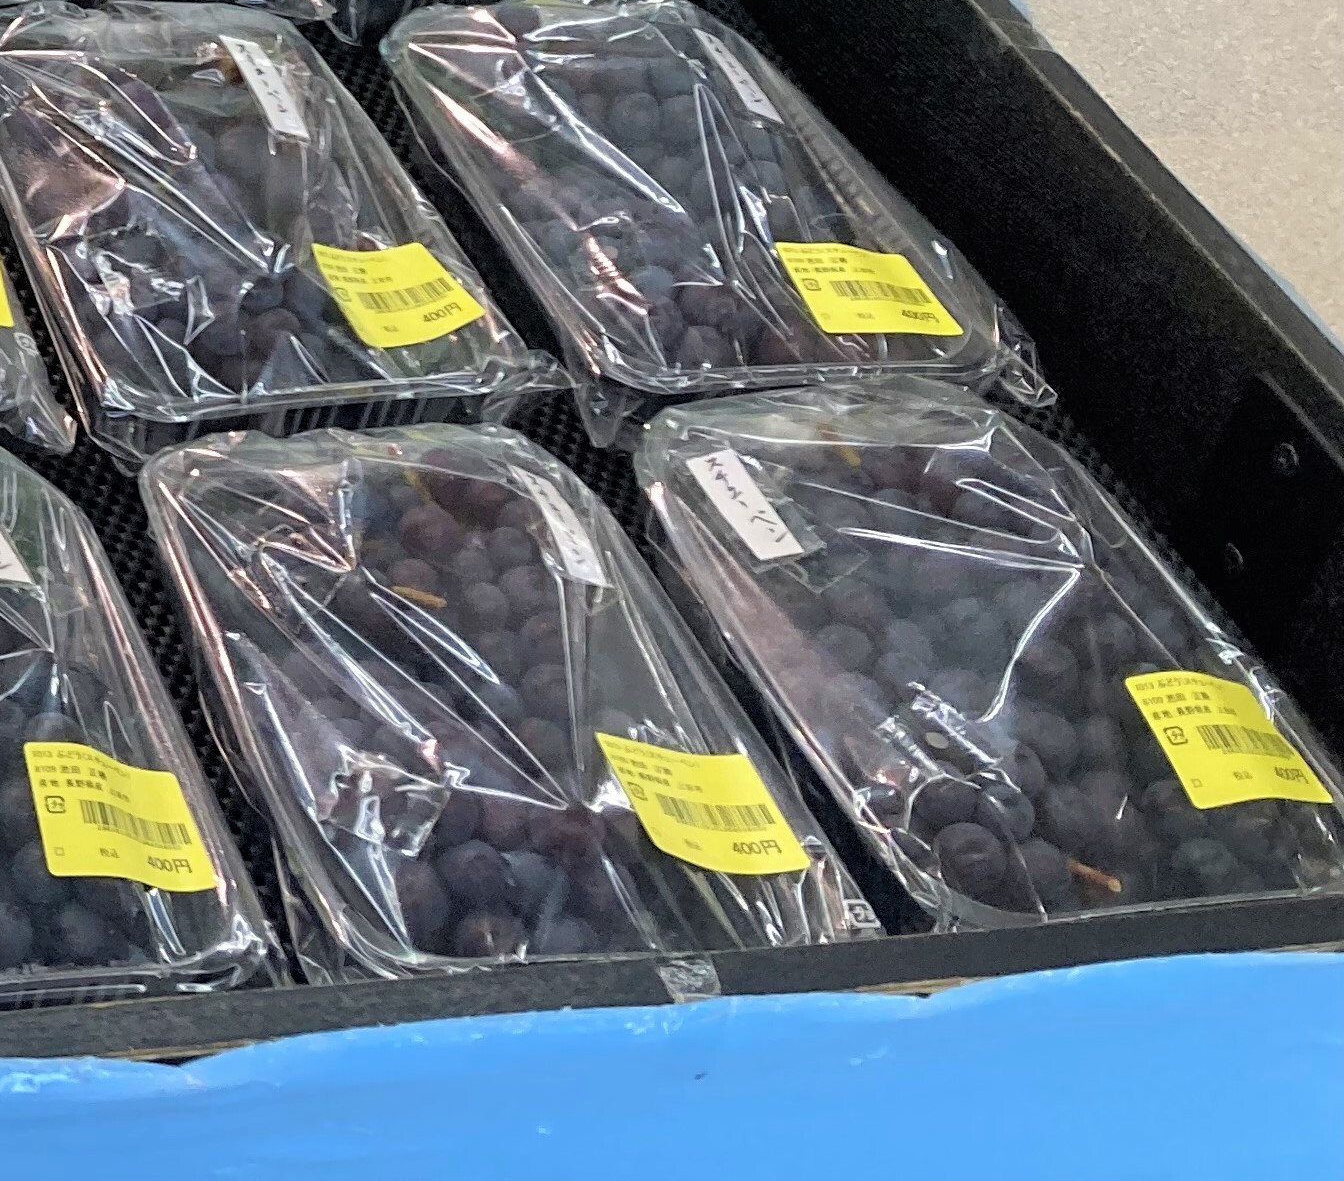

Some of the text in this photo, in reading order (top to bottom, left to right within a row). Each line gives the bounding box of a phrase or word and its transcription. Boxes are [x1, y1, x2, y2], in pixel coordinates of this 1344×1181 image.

[424, 303, 461, 323] 400円
[733, 840, 782, 855] 400円
[148, 855, 192, 873] 400円
